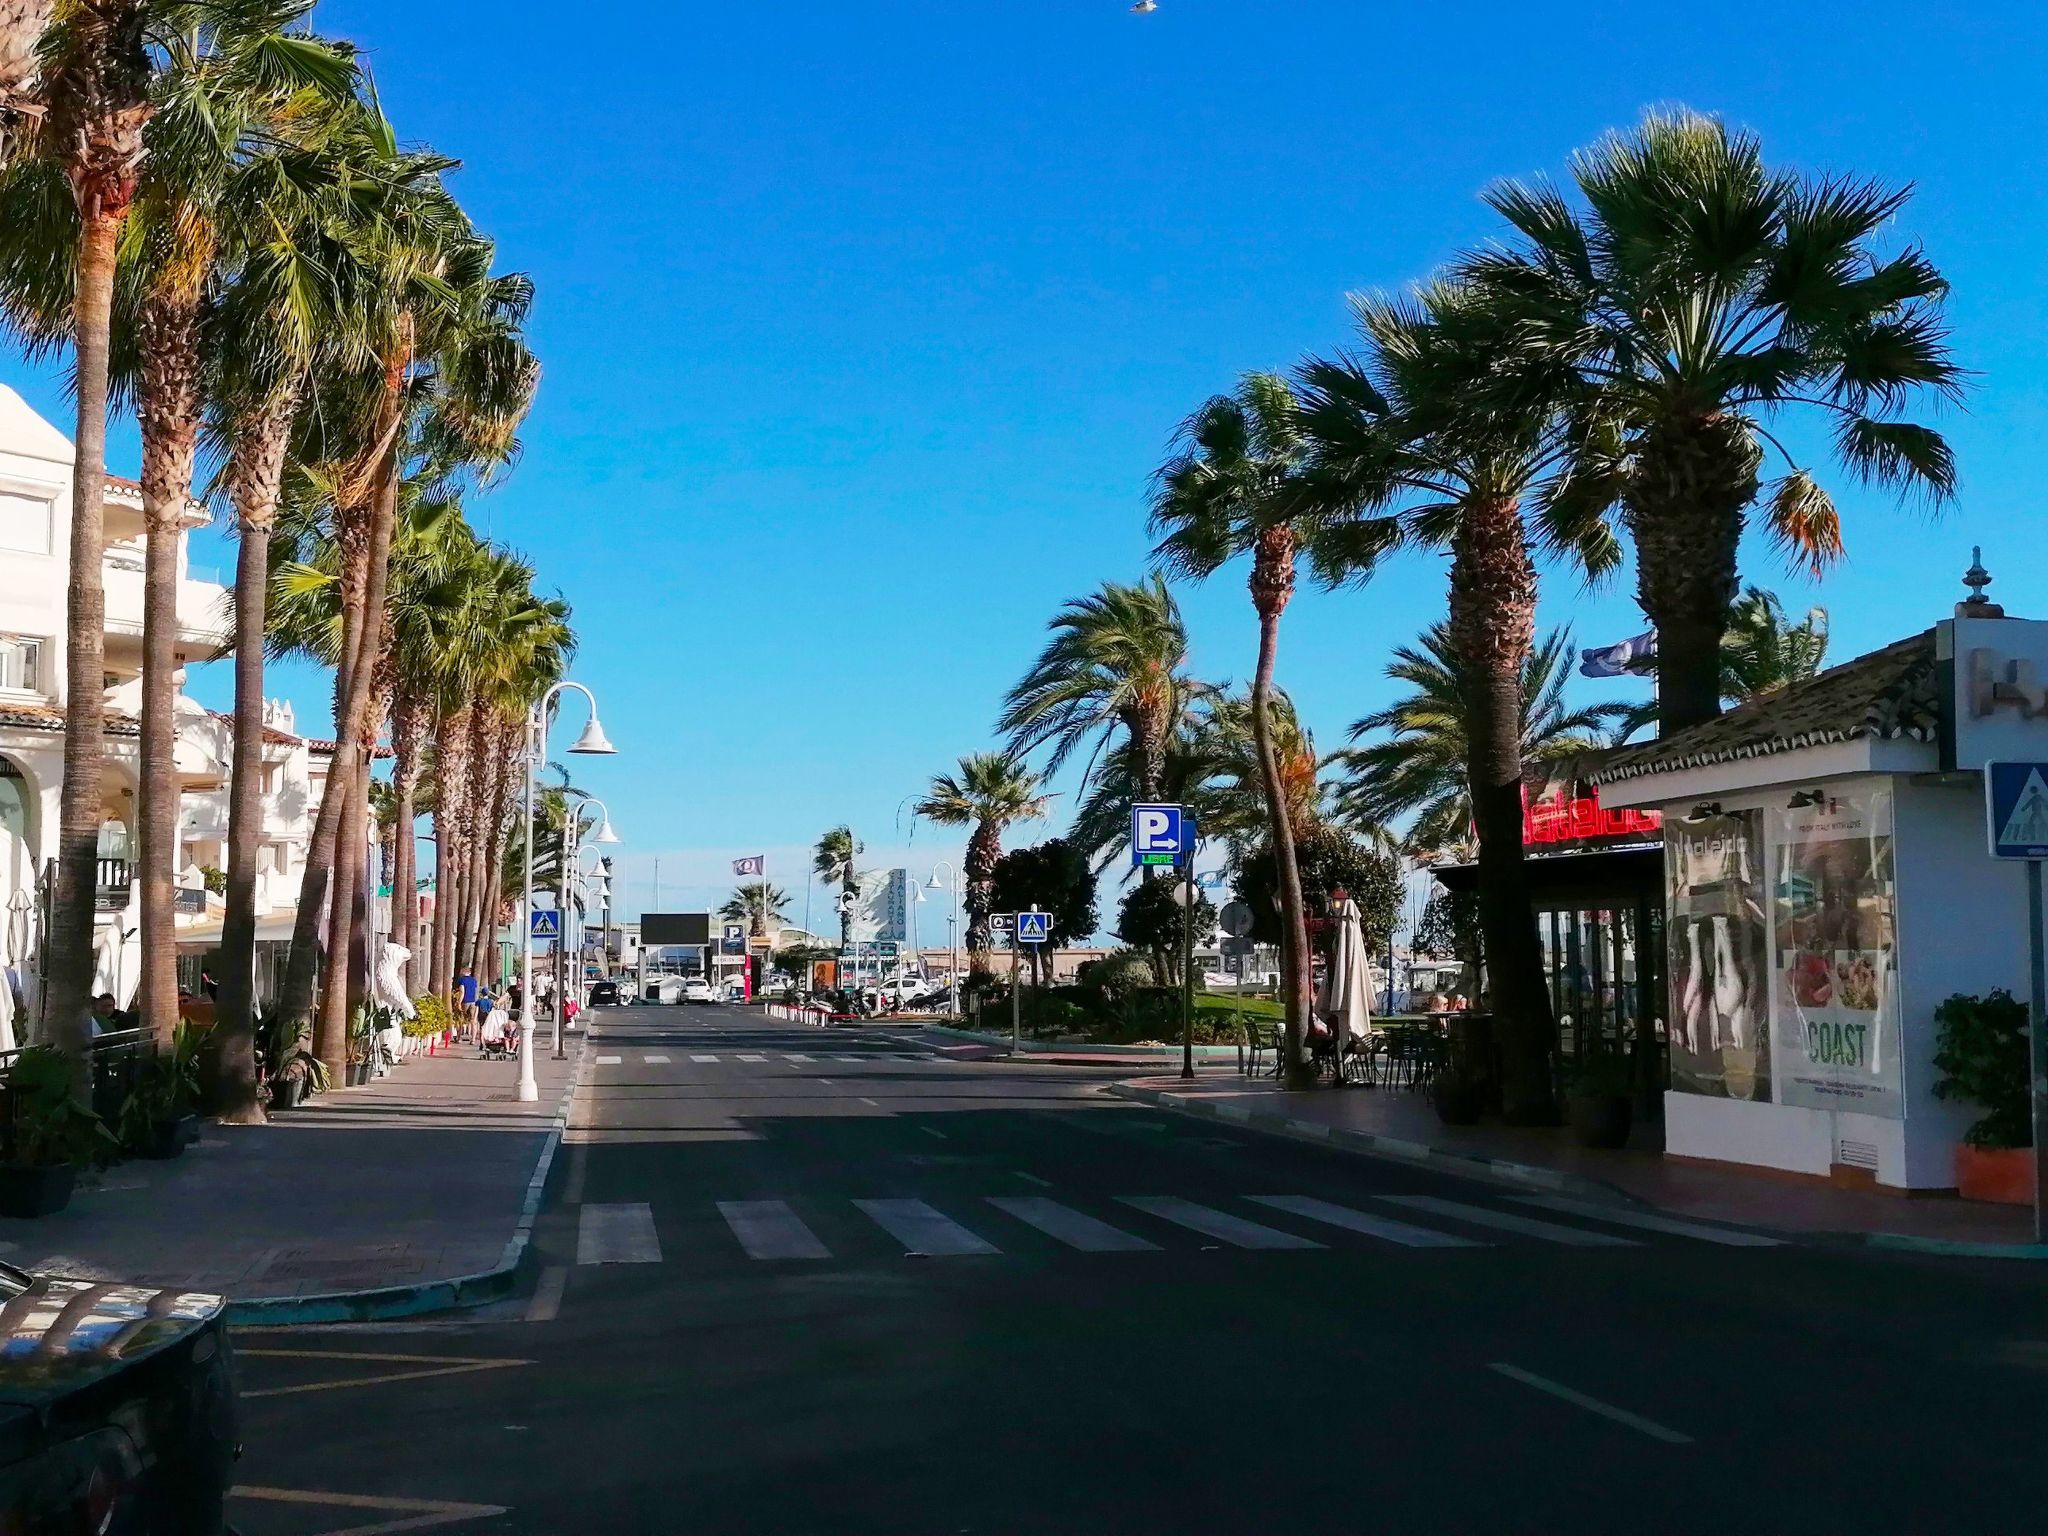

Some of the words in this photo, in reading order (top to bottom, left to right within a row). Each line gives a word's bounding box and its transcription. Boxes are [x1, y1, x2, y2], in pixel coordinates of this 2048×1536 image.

[1138, 811, 1169, 849] P
[1141, 854, 1174, 864] LIBRE
[897, 870, 905, 926] ITALIANO
[729, 926, 740, 939] P
[1807, 1020, 1866, 1067] COAST
